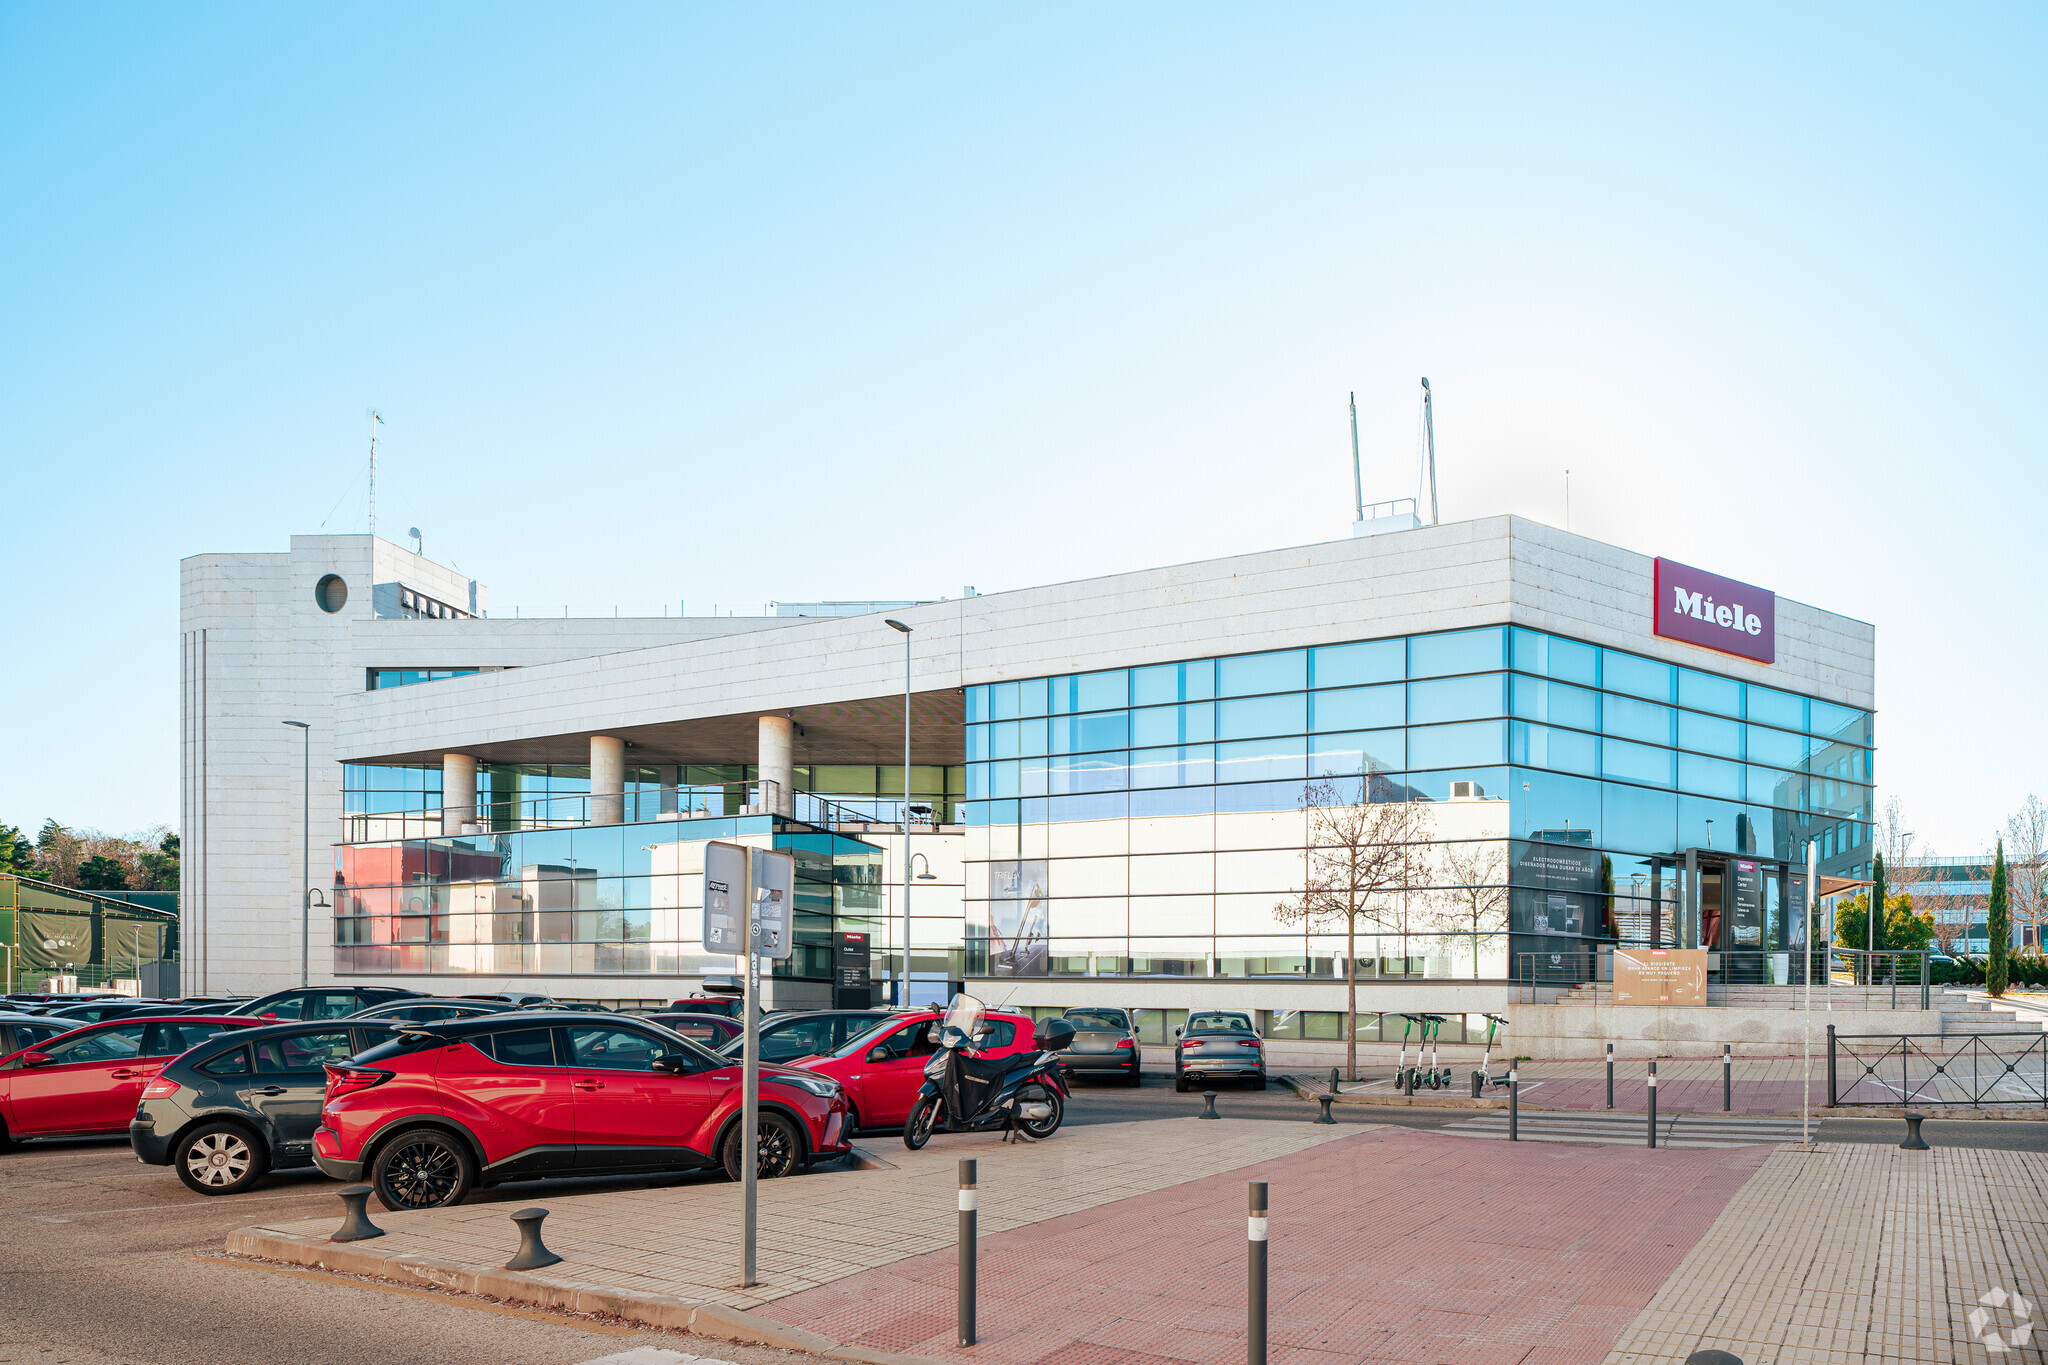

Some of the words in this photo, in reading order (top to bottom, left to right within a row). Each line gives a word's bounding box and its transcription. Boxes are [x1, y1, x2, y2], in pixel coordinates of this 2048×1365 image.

[1673, 586, 1762, 636] Miele
[1519, 861, 1546, 869] DISEÑADOS
[993, 871, 1021, 880] TRIFLEX
